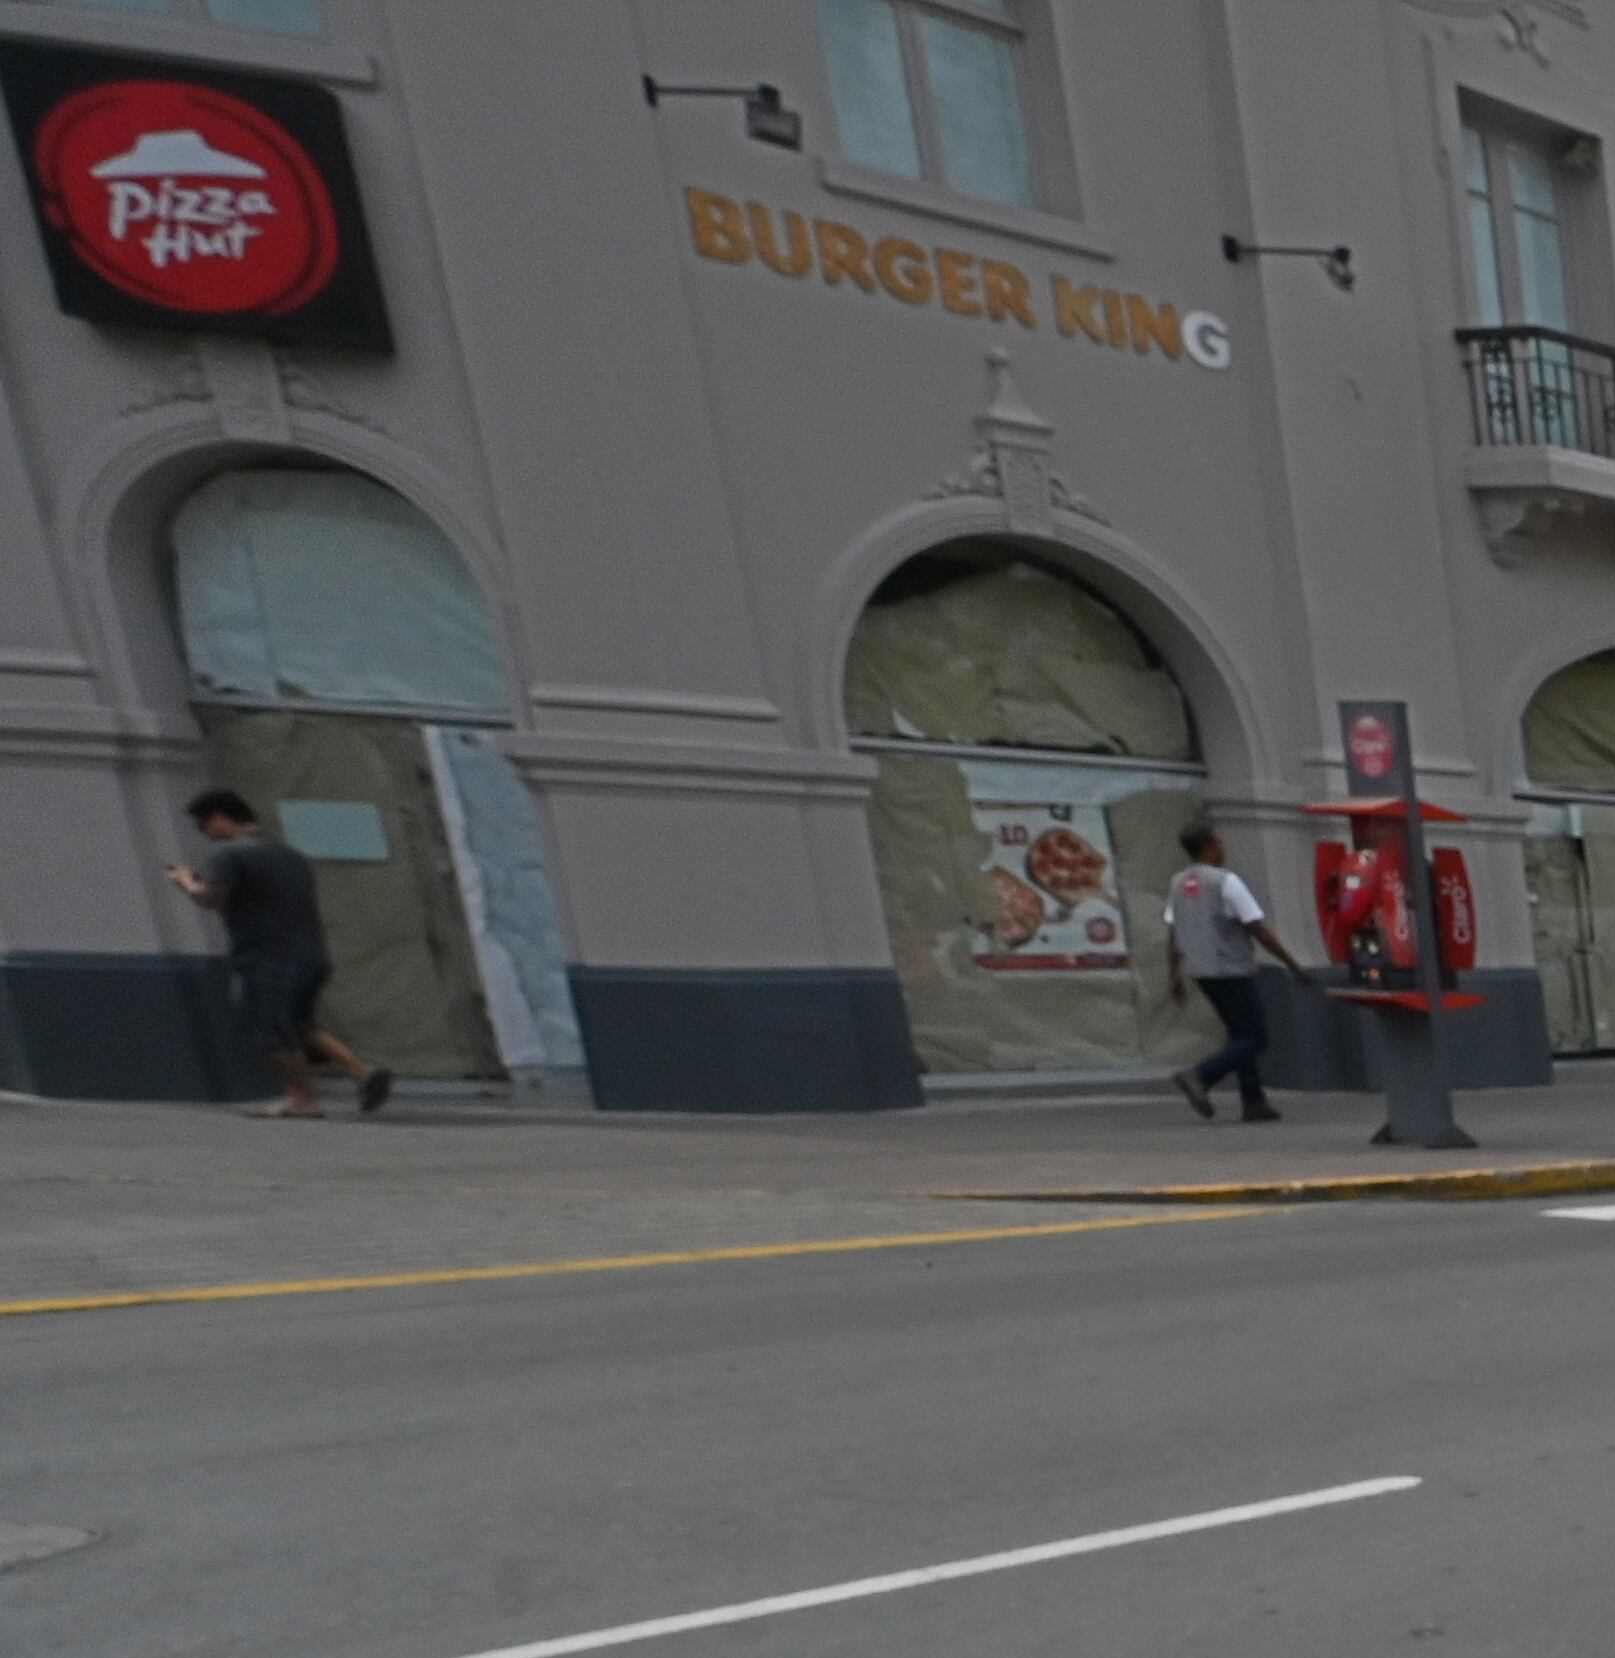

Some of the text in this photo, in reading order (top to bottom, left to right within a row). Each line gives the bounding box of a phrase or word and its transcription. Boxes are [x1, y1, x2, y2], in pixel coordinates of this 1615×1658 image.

[108, 178, 277, 240] Pizza
[142, 220, 263, 268] Hut
[686, 187, 1231, 370] BURGER KING
